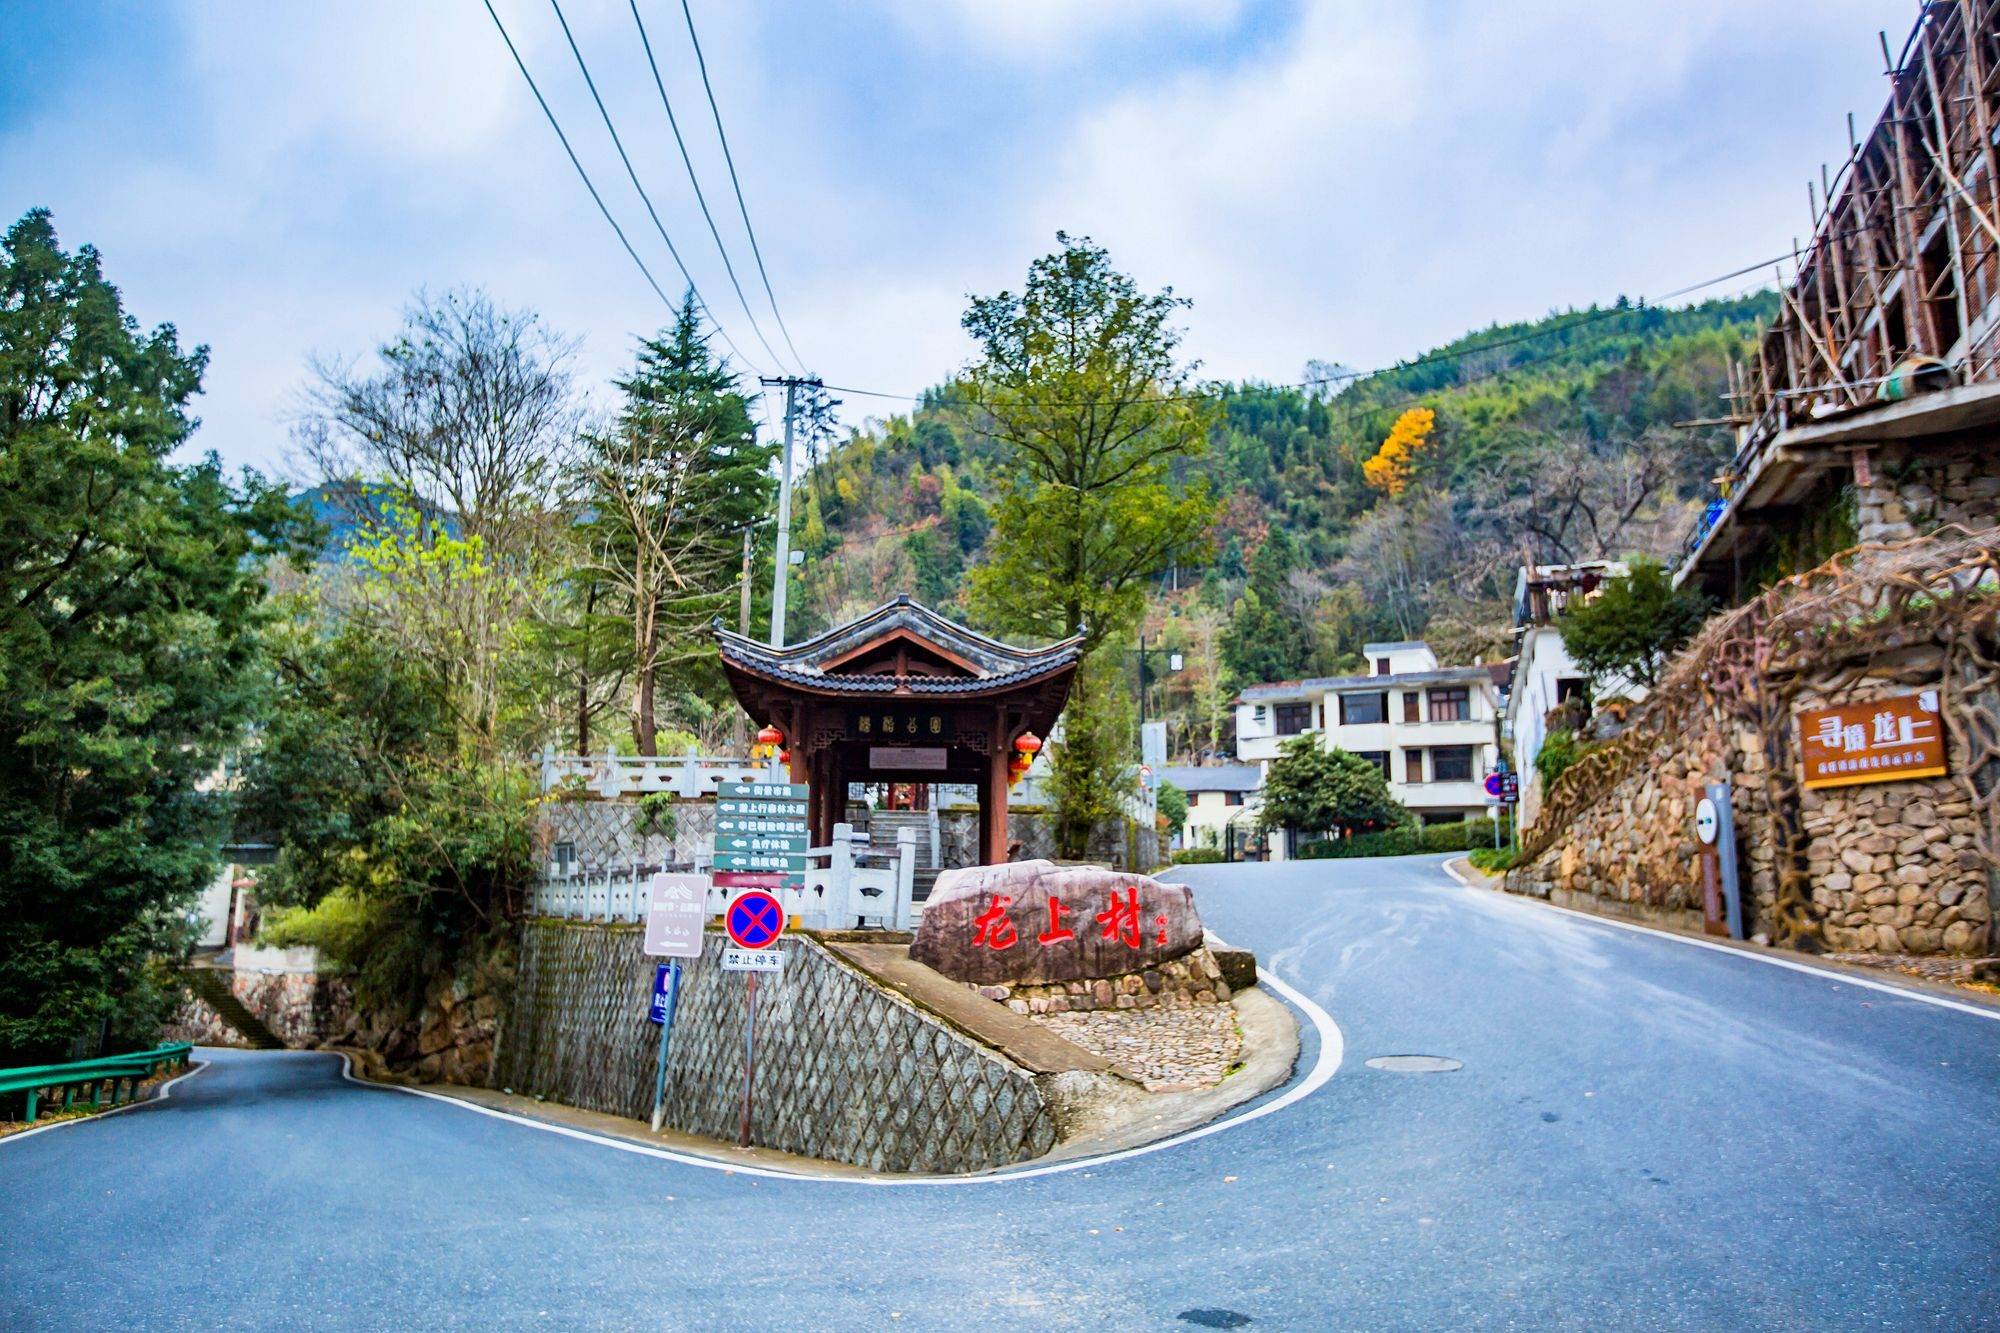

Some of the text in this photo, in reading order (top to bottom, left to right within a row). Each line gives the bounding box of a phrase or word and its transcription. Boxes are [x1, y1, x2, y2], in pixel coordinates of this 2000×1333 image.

[973, 887, 1141, 949] 龙上村
[728, 954, 779, 966] 禁止停车
